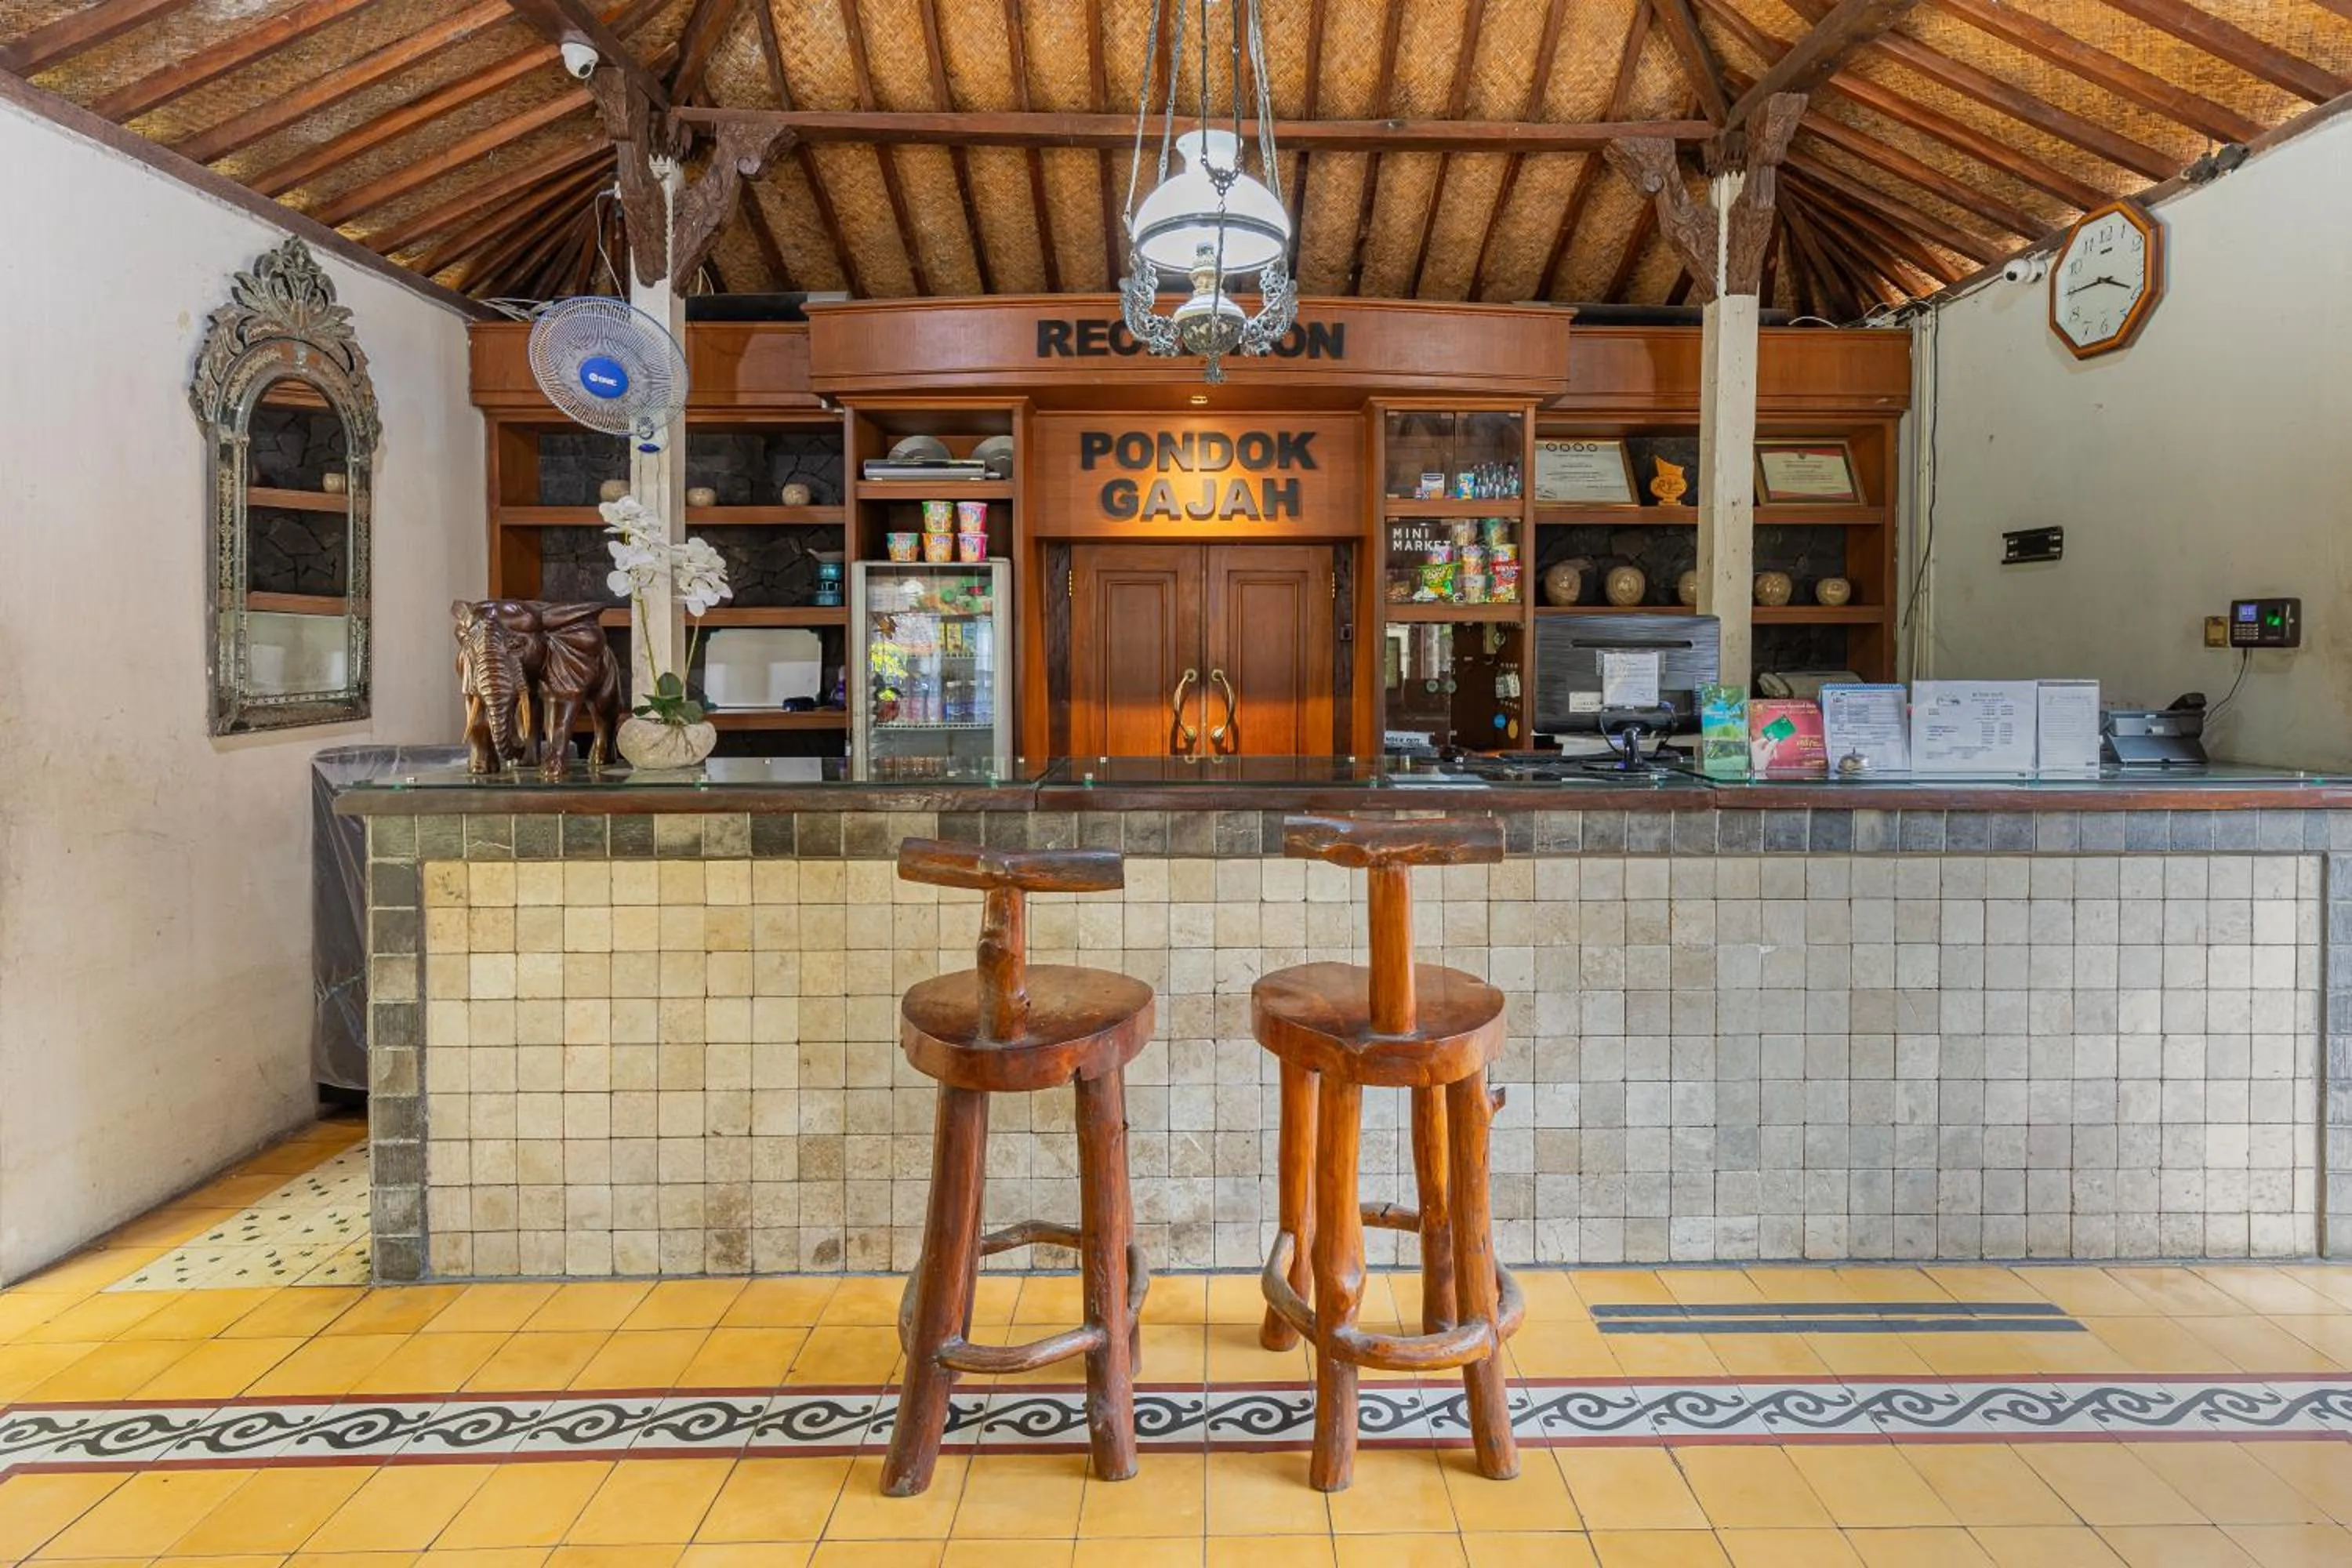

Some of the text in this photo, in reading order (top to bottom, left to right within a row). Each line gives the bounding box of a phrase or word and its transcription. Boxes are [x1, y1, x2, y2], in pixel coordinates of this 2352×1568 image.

[1037, 319, 1345, 359] RECON
[1080, 431, 1318, 472] PONDOK
[1101, 477, 1301, 521] GAJAH
[1392, 528, 1430, 539] MINI
[1392, 540, 1451, 551] MARKET
